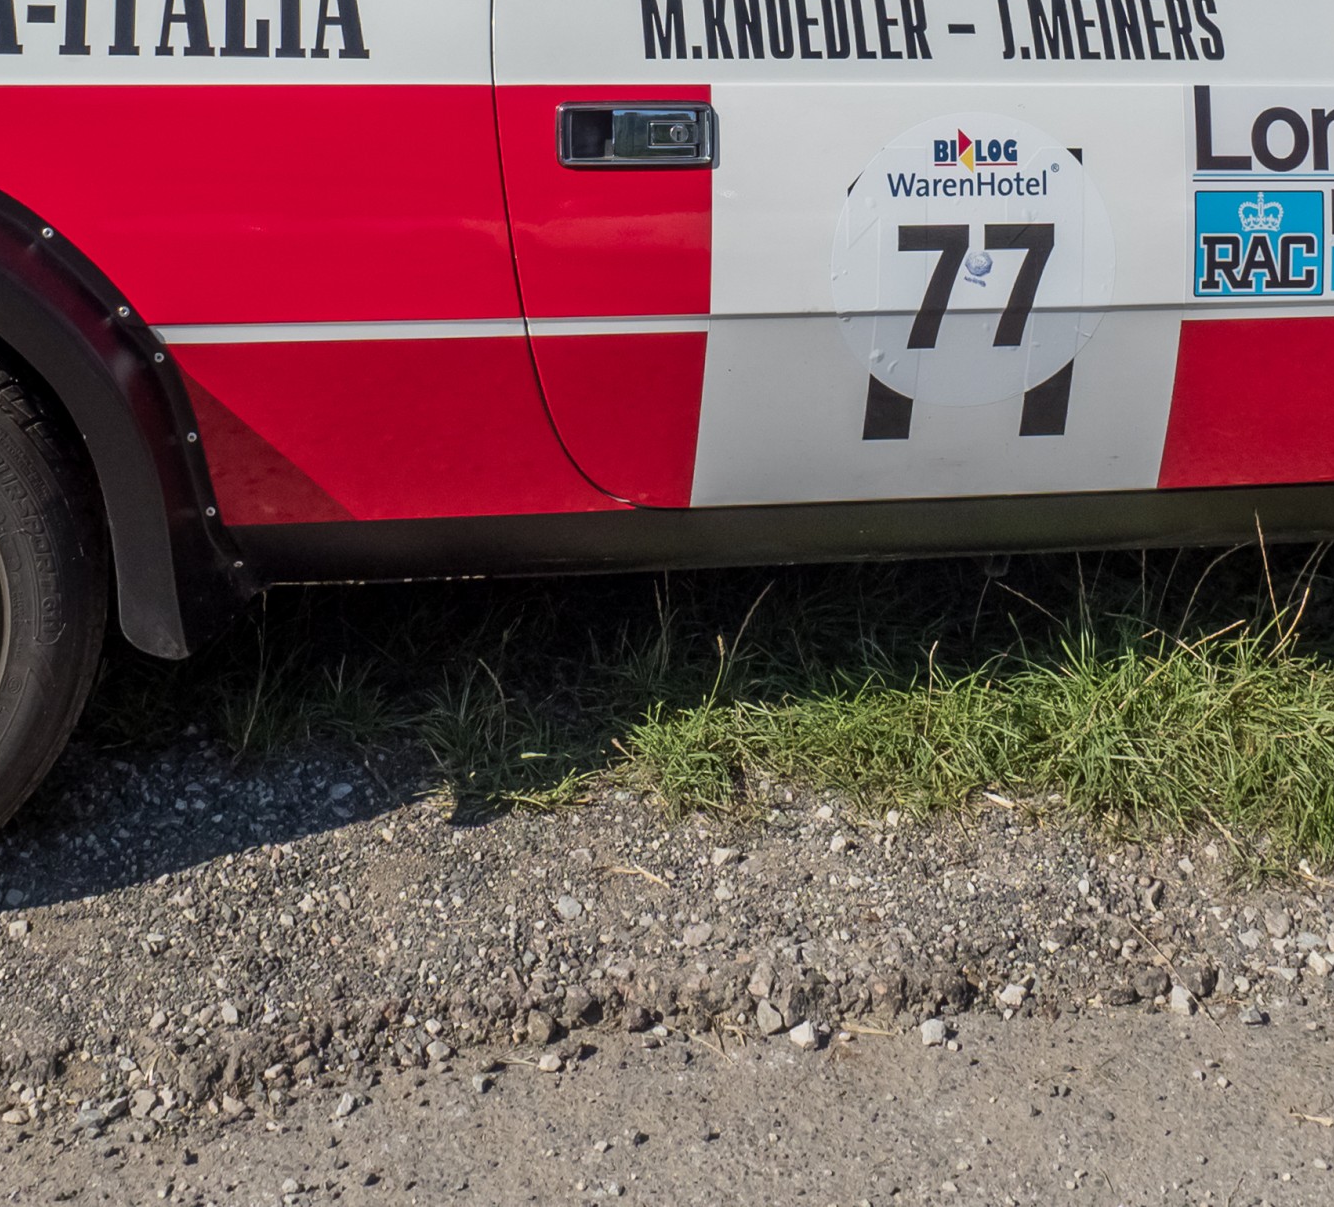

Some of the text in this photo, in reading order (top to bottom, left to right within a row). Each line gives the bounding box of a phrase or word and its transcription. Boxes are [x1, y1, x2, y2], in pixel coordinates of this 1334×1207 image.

[887, 170, 1047, 197] WarenHotel
[898, 223, 1055, 349] 77
[1200, 233, 1318, 291] RAC
